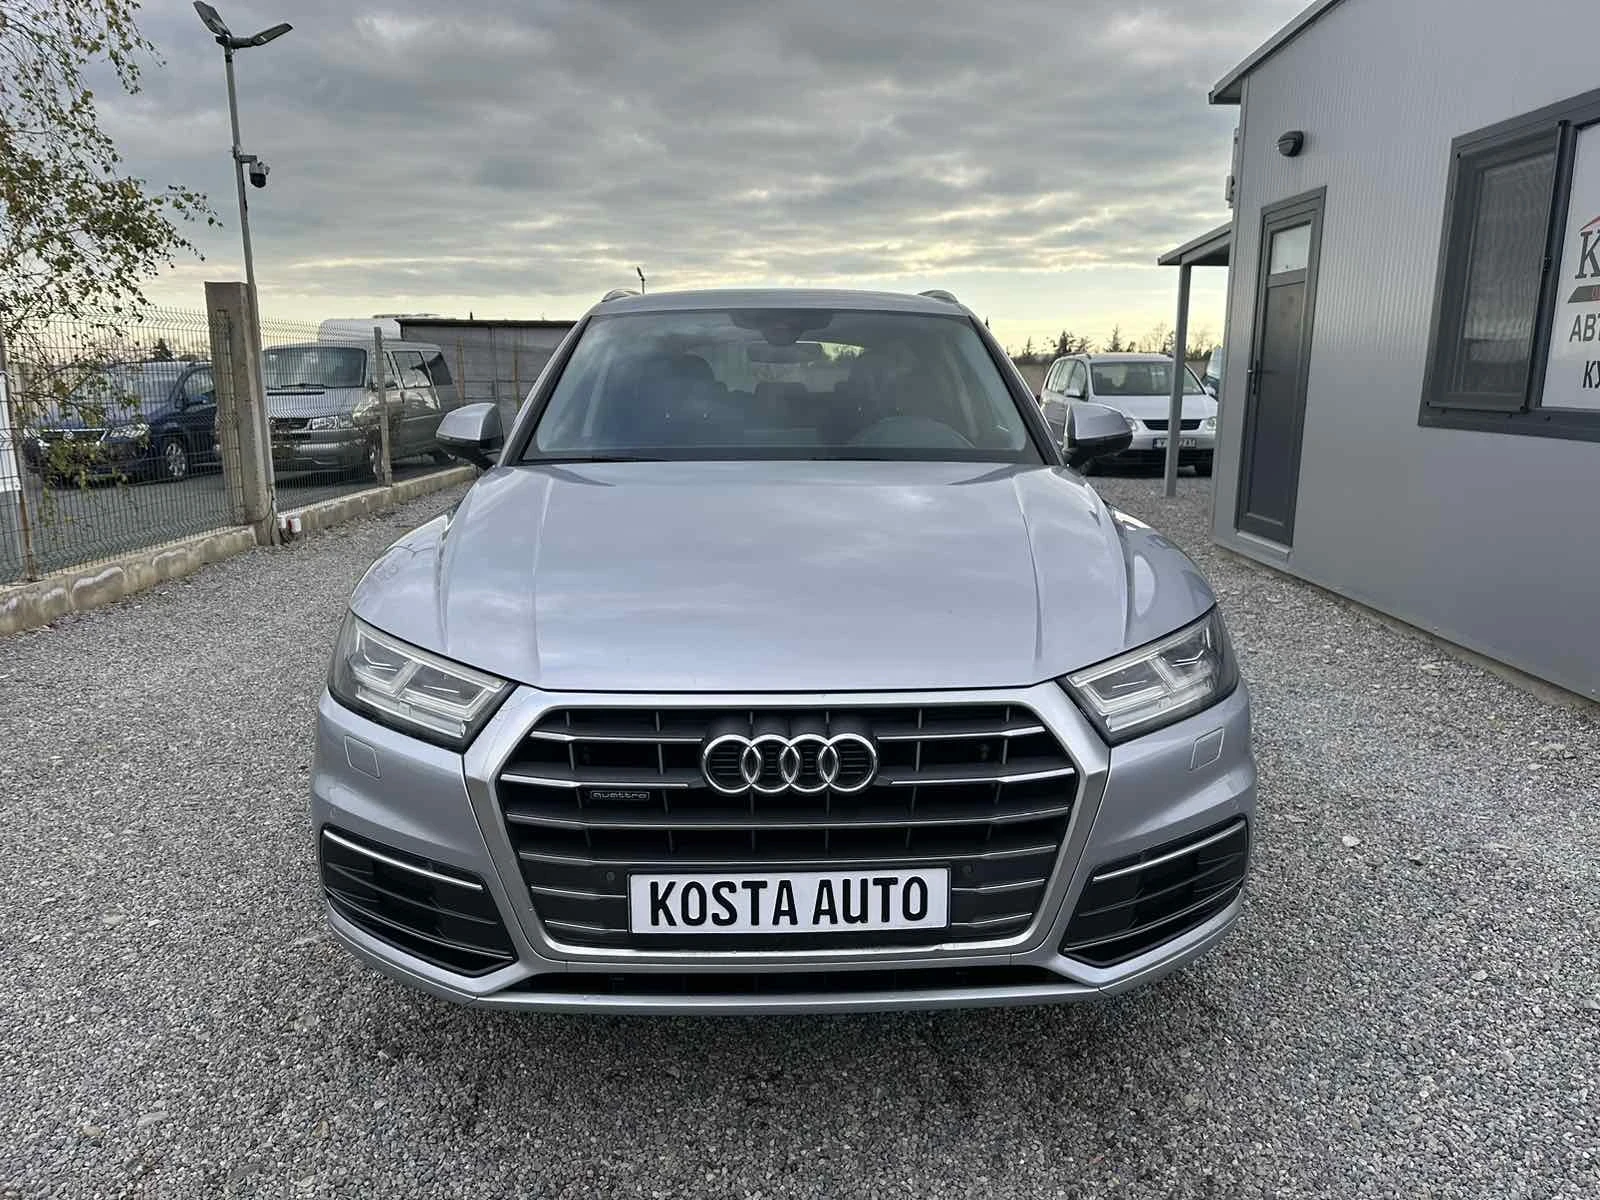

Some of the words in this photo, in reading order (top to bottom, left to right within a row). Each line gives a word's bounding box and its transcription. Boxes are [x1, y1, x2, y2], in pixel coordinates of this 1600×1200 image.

[591, 791, 648, 800] quattro
[649, 880, 799, 927] KOSTA
[812, 875, 930, 926] AUTO
